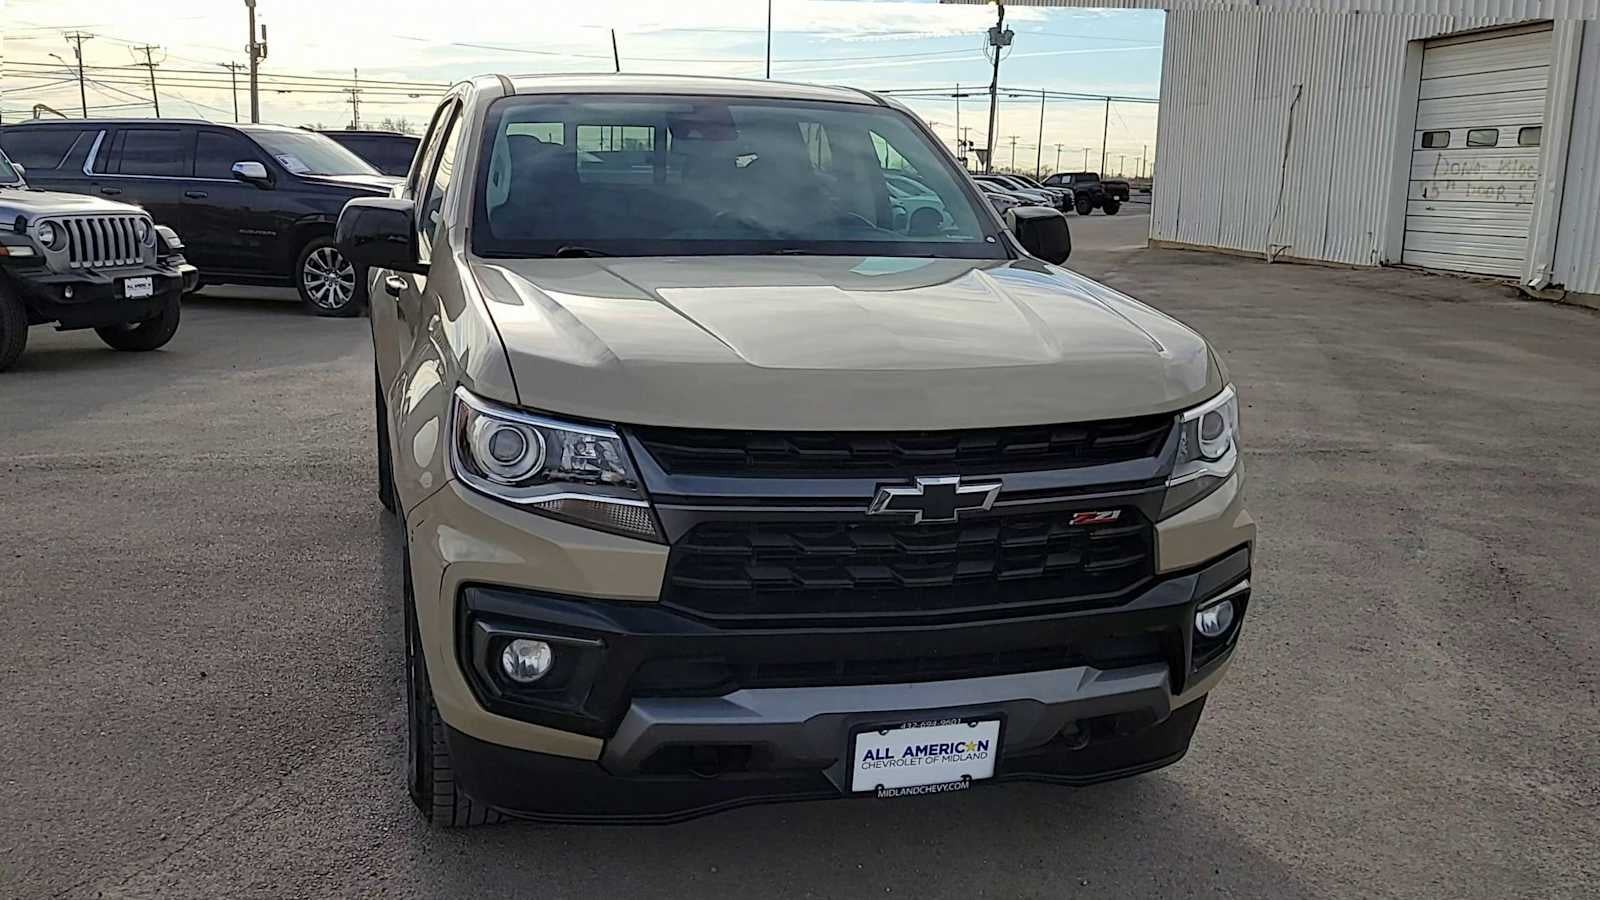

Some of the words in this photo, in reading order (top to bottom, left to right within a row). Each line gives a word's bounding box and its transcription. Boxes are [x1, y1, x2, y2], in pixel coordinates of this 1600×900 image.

[1069, 510, 1121, 525] Z71
[861, 757, 922, 770] CHEVROLET
[925, 756, 940, 765] OF
[942, 752, 988, 764] MIDLAND
[863, 748, 895, 762] ALL
[877, 781, 970, 798] MIDLANDCHEVY.COM
